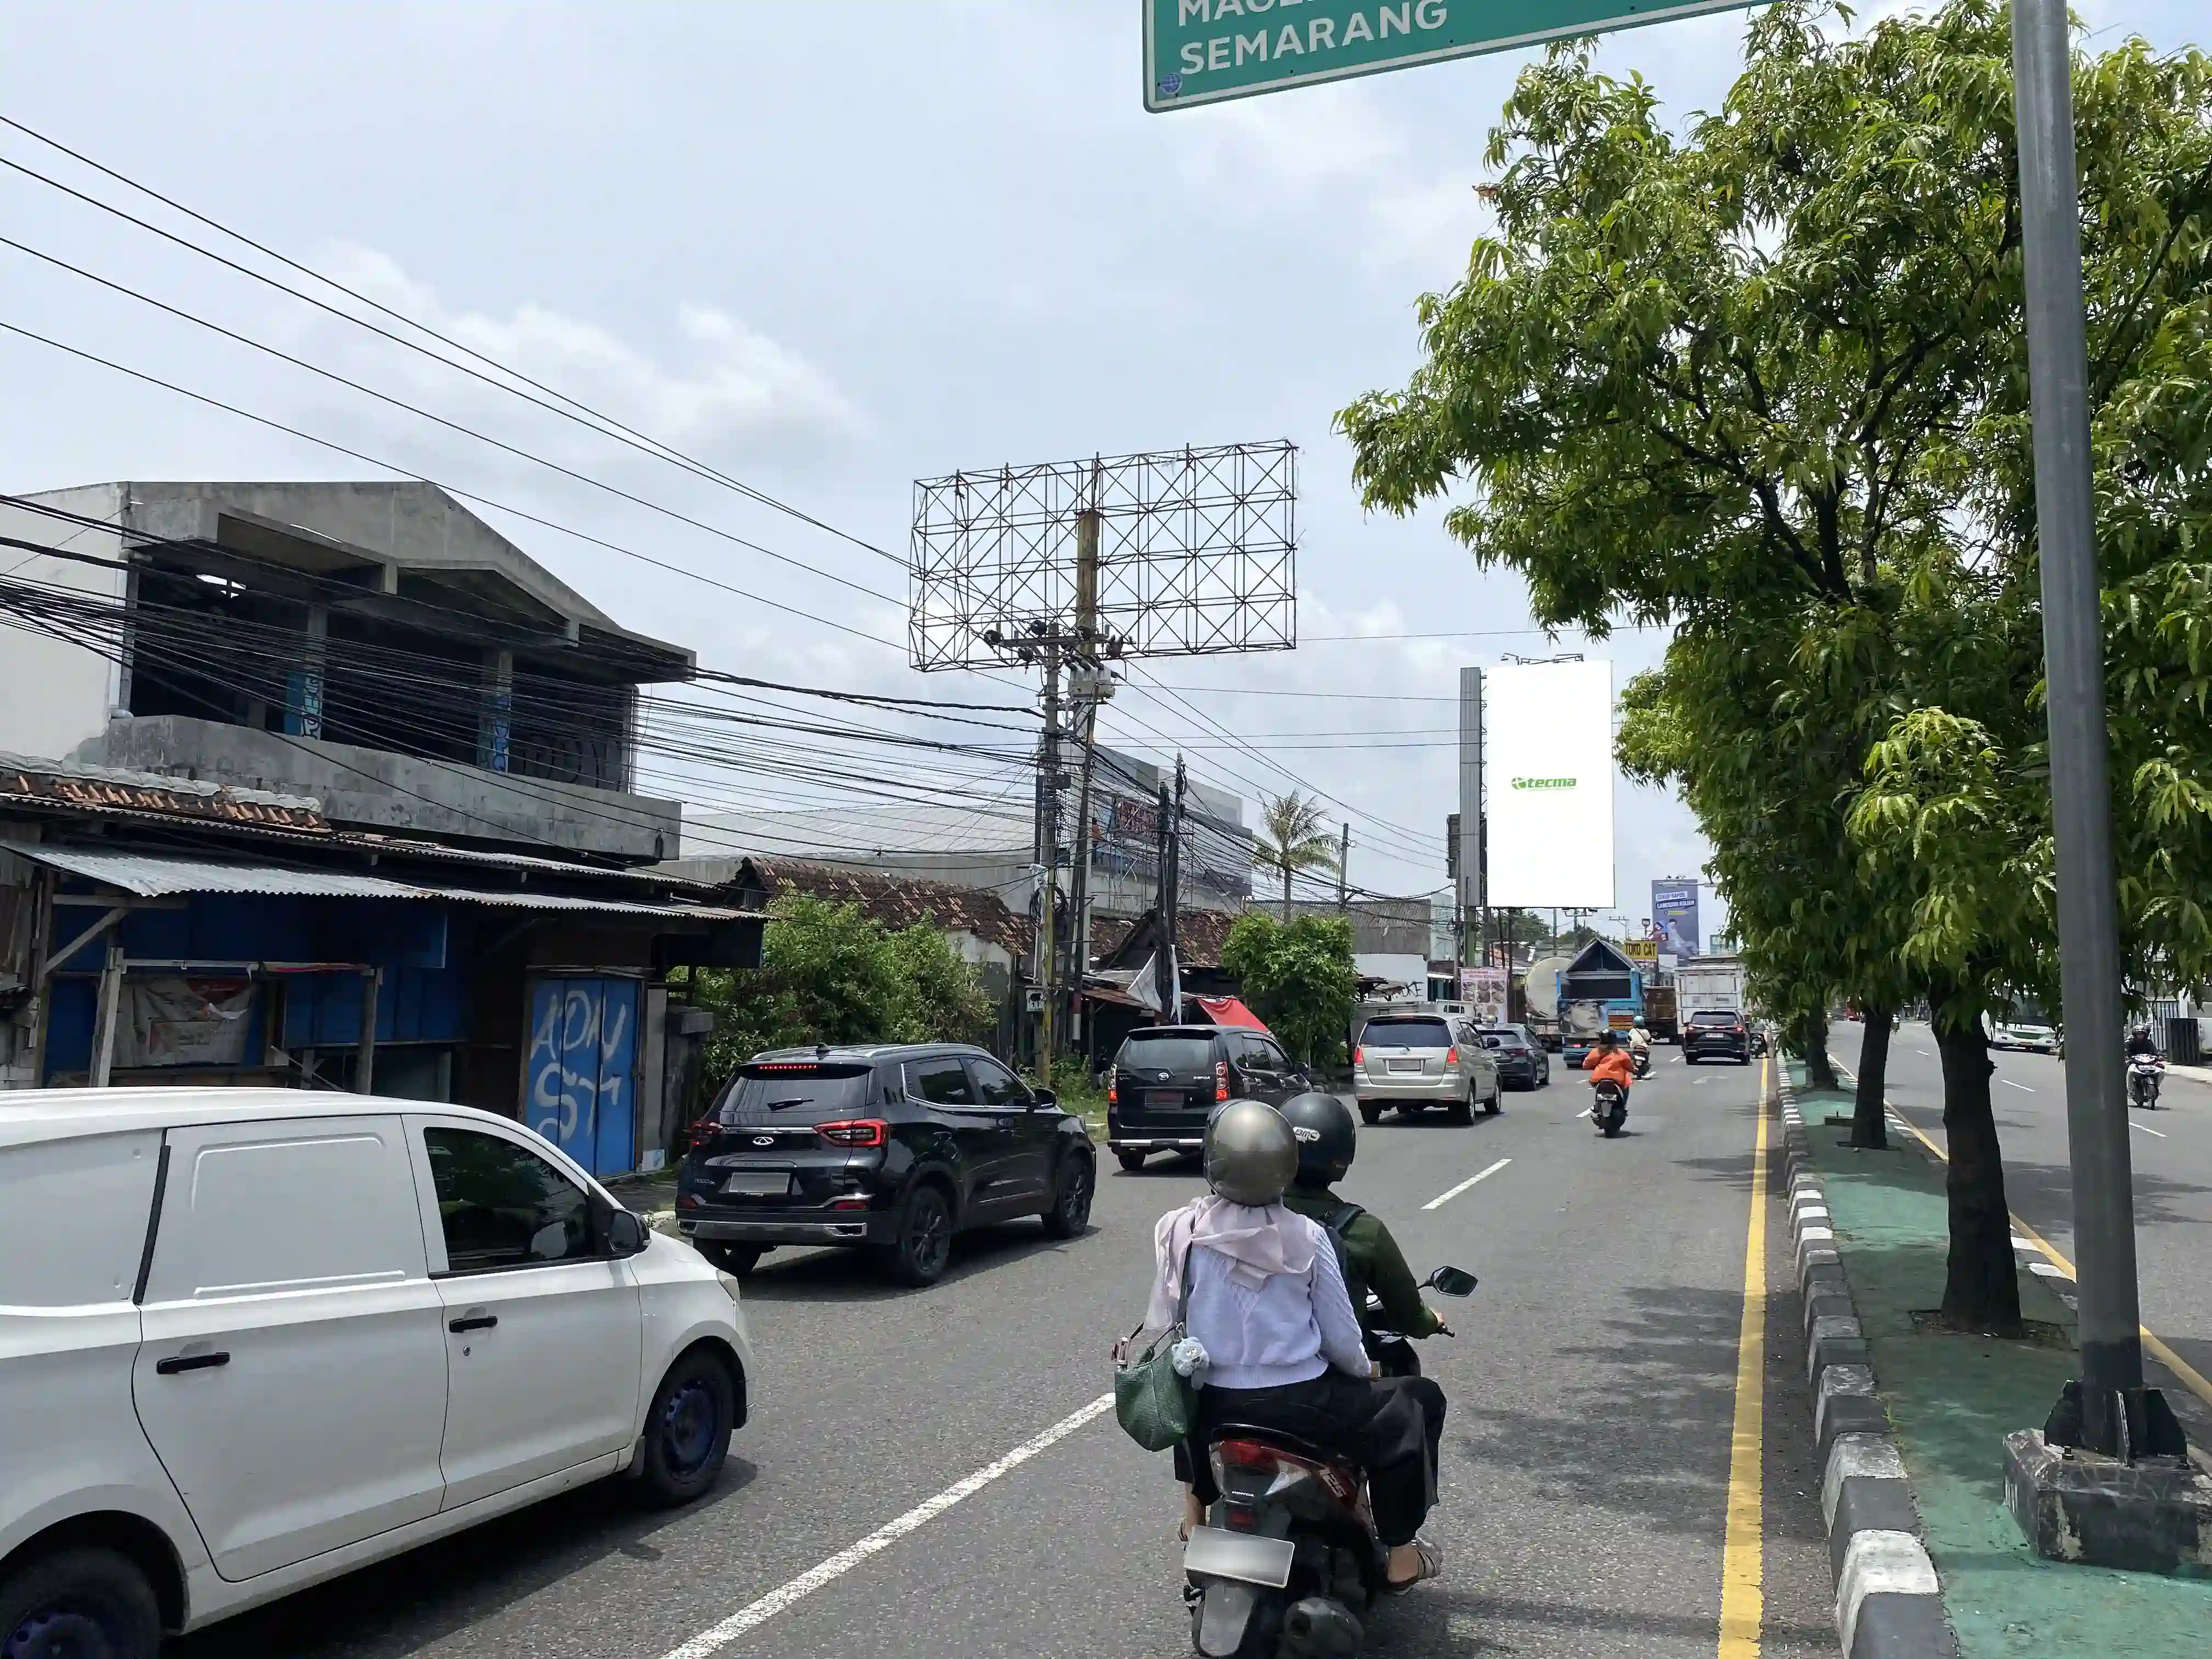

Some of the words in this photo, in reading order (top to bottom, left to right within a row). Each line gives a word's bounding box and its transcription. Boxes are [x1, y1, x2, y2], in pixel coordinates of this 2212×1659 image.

[1180, 0, 1448, 75] SEMARANG
[1527, 778, 1577, 788] tecma
[1644, 943, 1656, 957] CAT
[1319, 1468, 1347, 1498] 125
